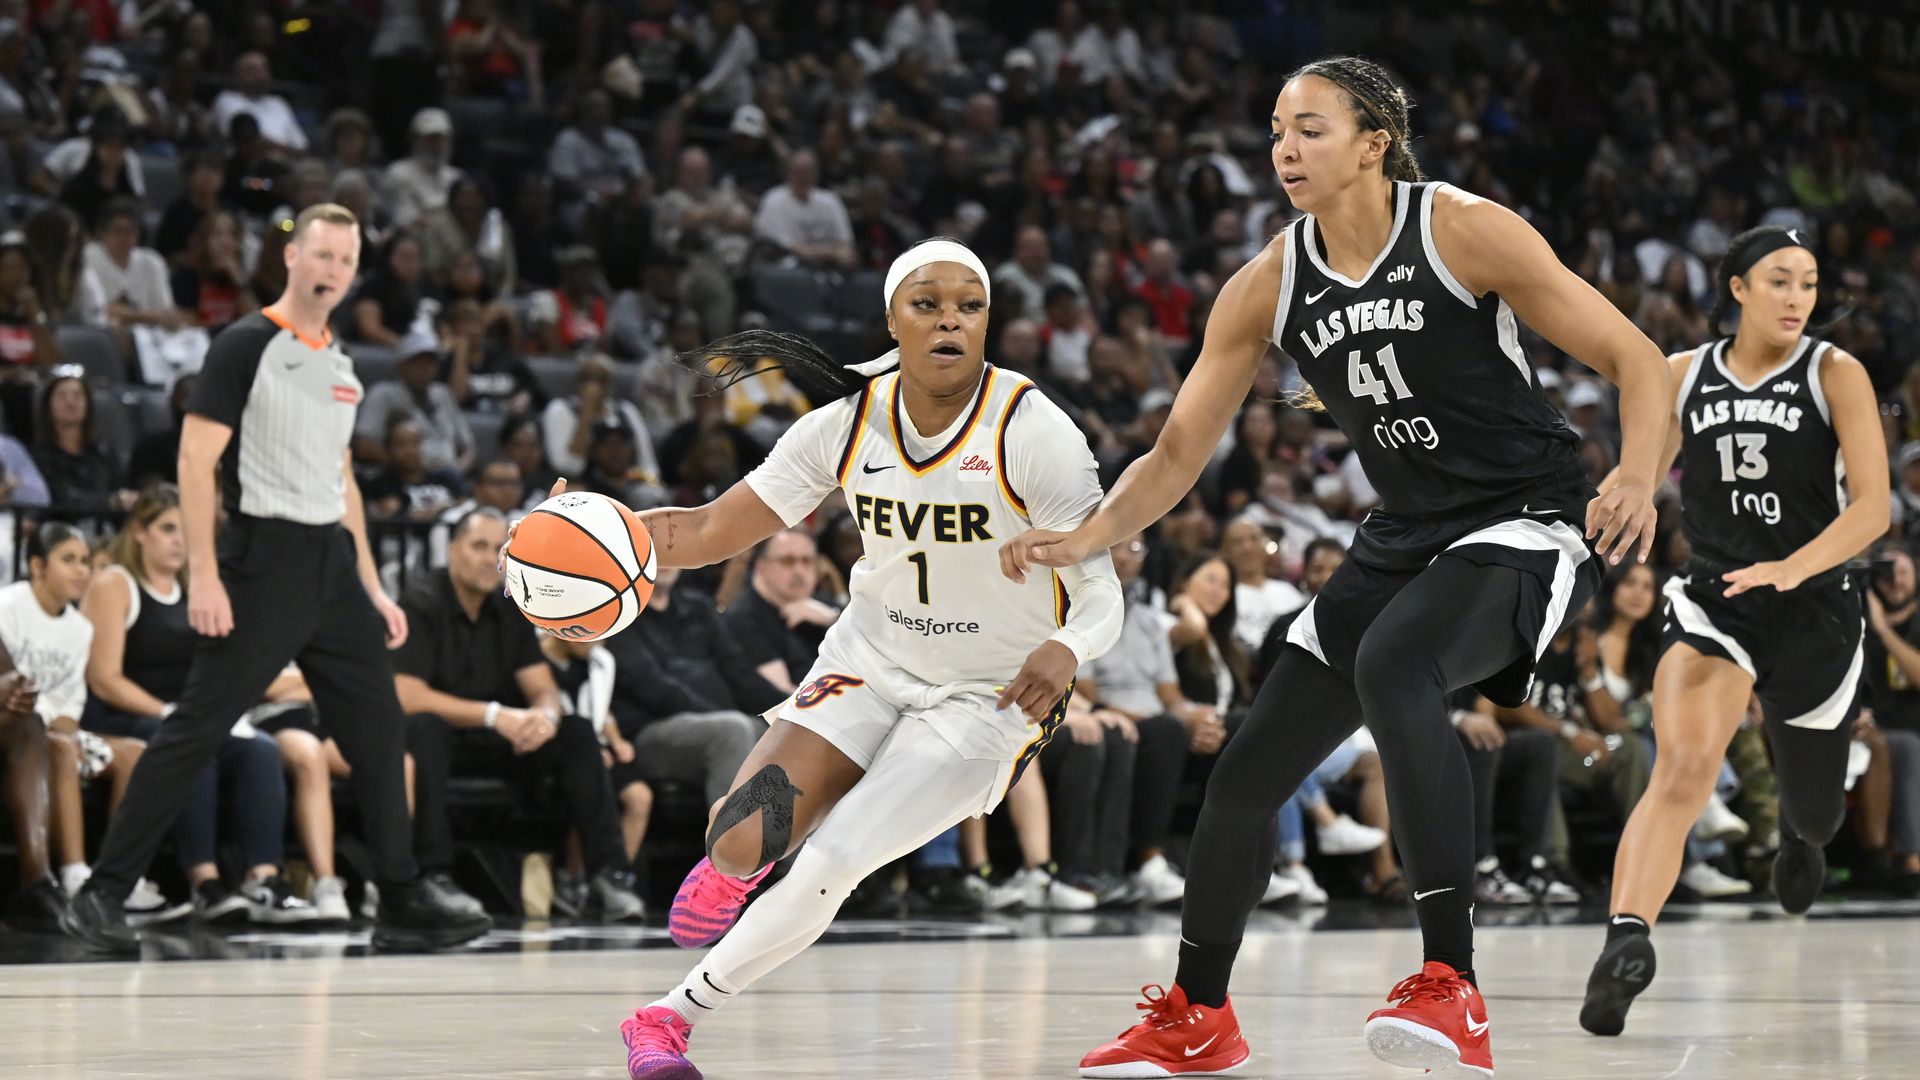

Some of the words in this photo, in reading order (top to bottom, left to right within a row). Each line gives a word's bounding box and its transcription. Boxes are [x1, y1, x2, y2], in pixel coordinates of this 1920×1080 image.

[1387, 264, 1416, 282] ally
[1300, 310, 1346, 358] LAS
[1345, 298, 1425, 334] VEGAS
[1348, 343, 1414, 405] 41
[1772, 380, 1800, 395] ally
[1373, 415, 1440, 450] ring
[1689, 400, 1731, 434] LAS
[1733, 399, 1803, 432] VEGAS
[959, 455, 994, 475] Lilly
[1715, 433, 1769, 482] 13
[855, 493, 996, 543] FEVER
[1731, 489, 1782, 525] rng
[907, 550, 930, 606] 1
[884, 605, 979, 637] alesforce
[1612, 956, 1646, 982] 12
